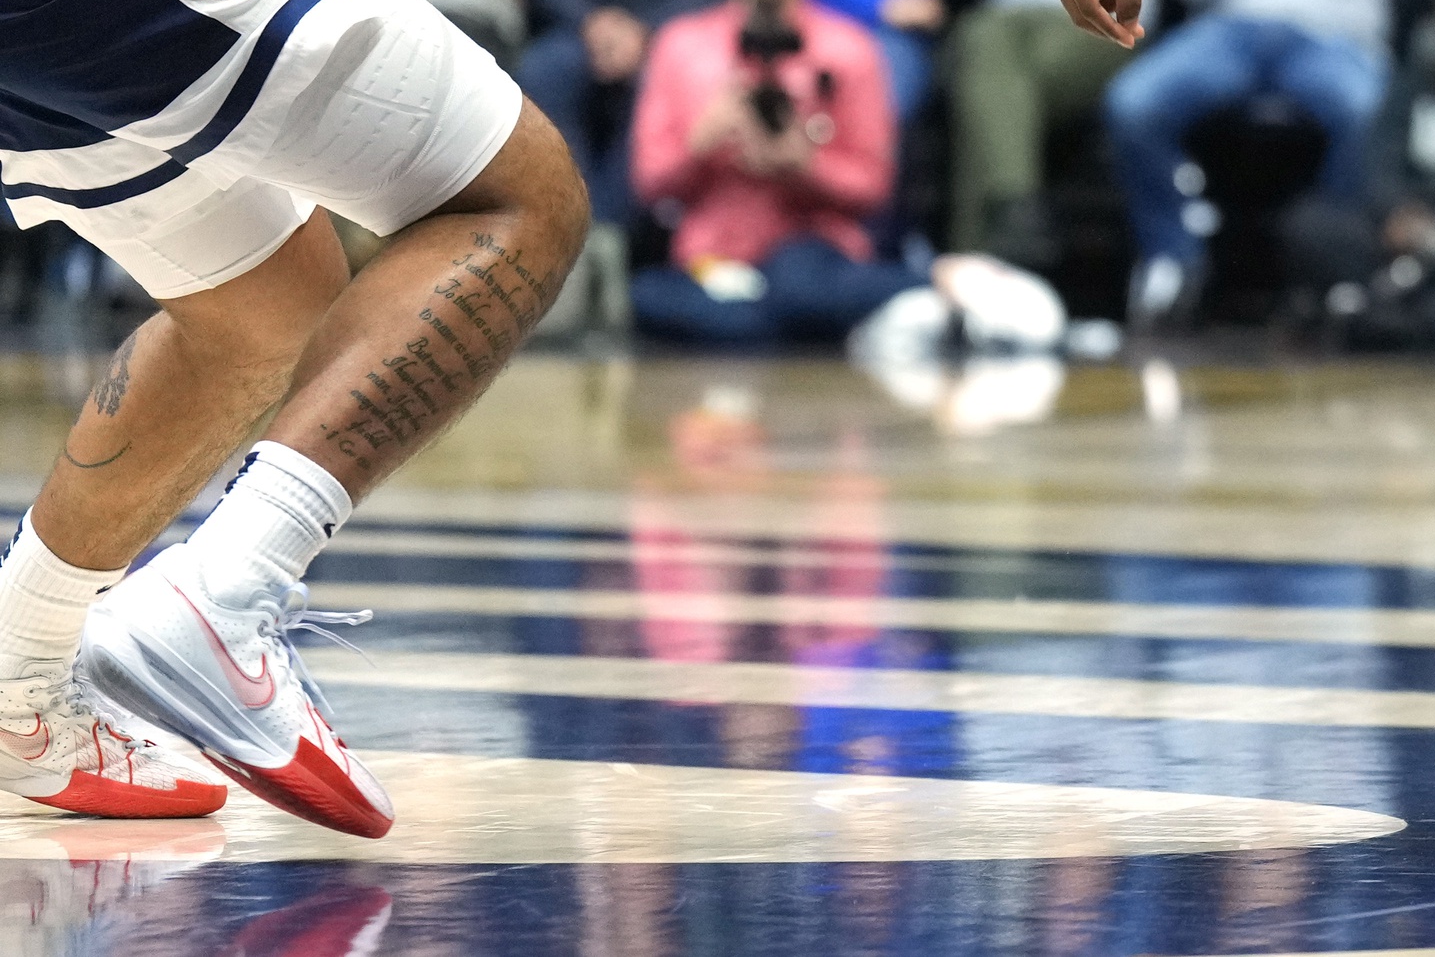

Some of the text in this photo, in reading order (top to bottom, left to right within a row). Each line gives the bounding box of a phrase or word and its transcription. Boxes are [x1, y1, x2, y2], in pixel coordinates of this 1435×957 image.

[470, 232, 506, 257] When
[434, 278, 461, 299] To
[453, 292, 491, 319] think
[419, 308, 432, 320] to
[407, 336, 433, 362] But
